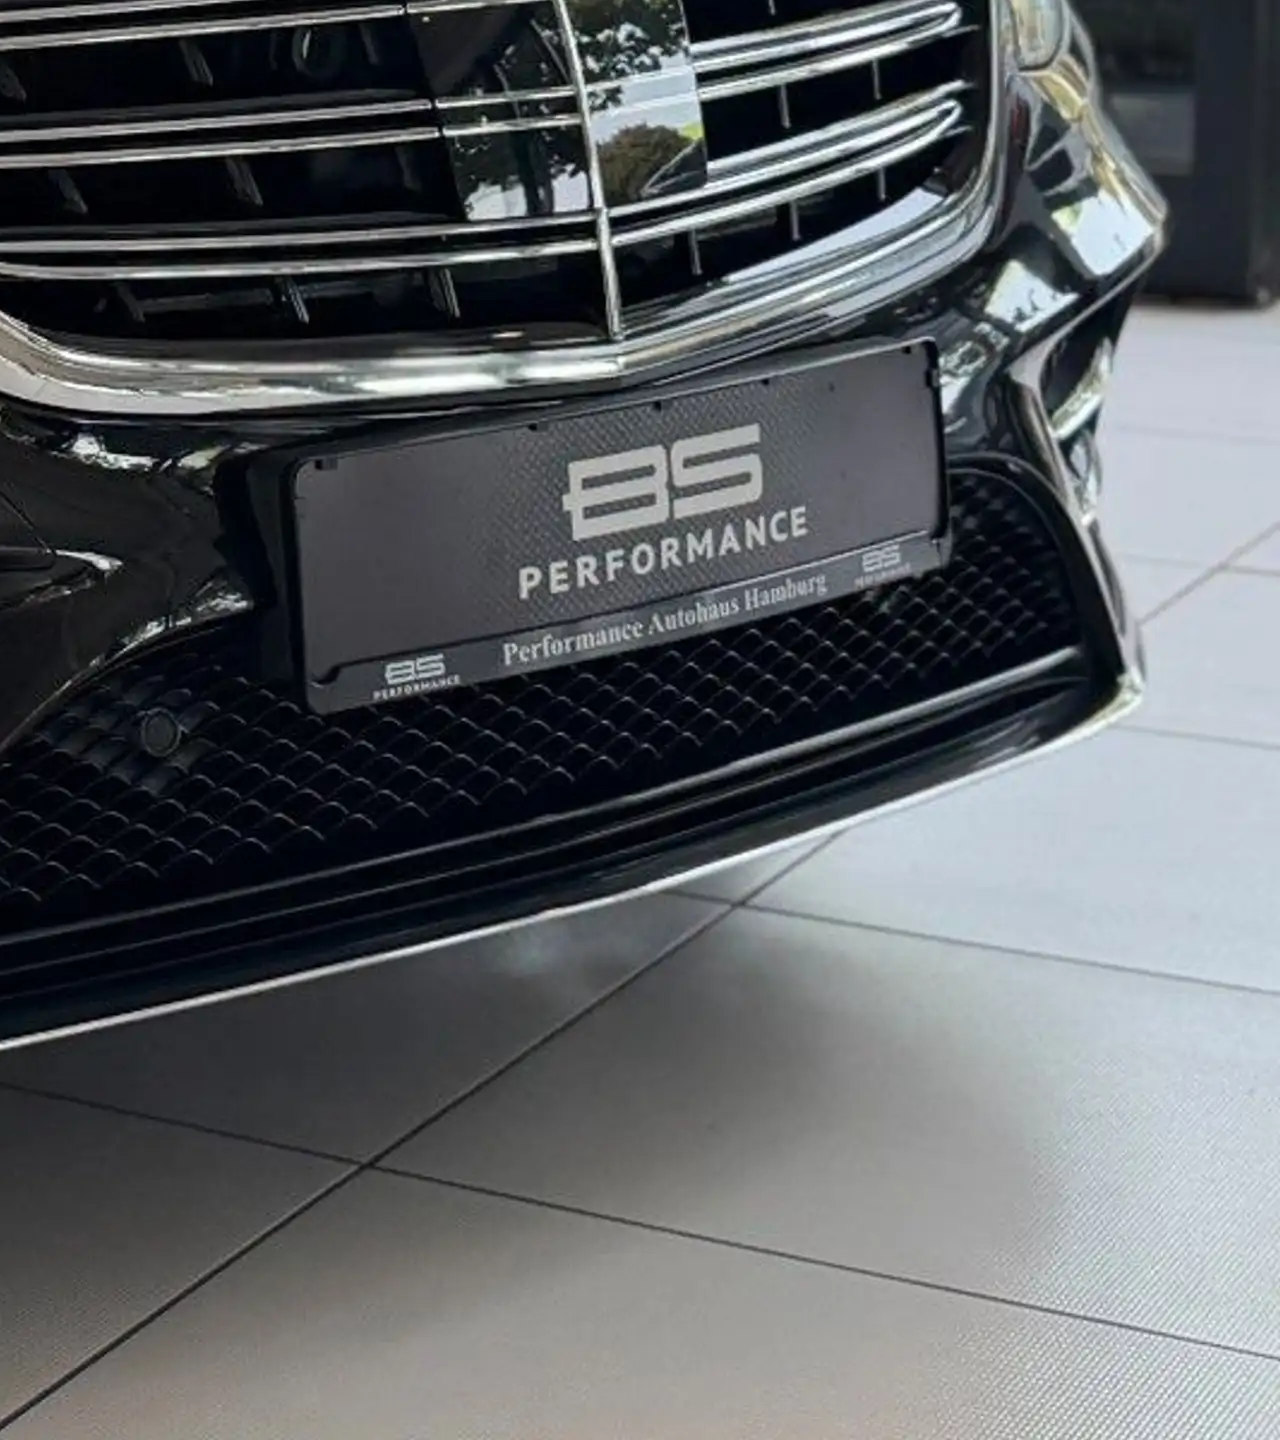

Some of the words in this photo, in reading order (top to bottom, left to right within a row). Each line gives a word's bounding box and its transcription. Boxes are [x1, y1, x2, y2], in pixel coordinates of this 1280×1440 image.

[562, 423, 764, 541] BS
[518, 505, 810, 600] PERFORMANCE
[502, 620, 643, 666] Performance
[648, 595, 739, 634] Autohaus
[744, 573, 827, 611] Hamburg
[372, 674, 461, 701] PERFORMANCE
